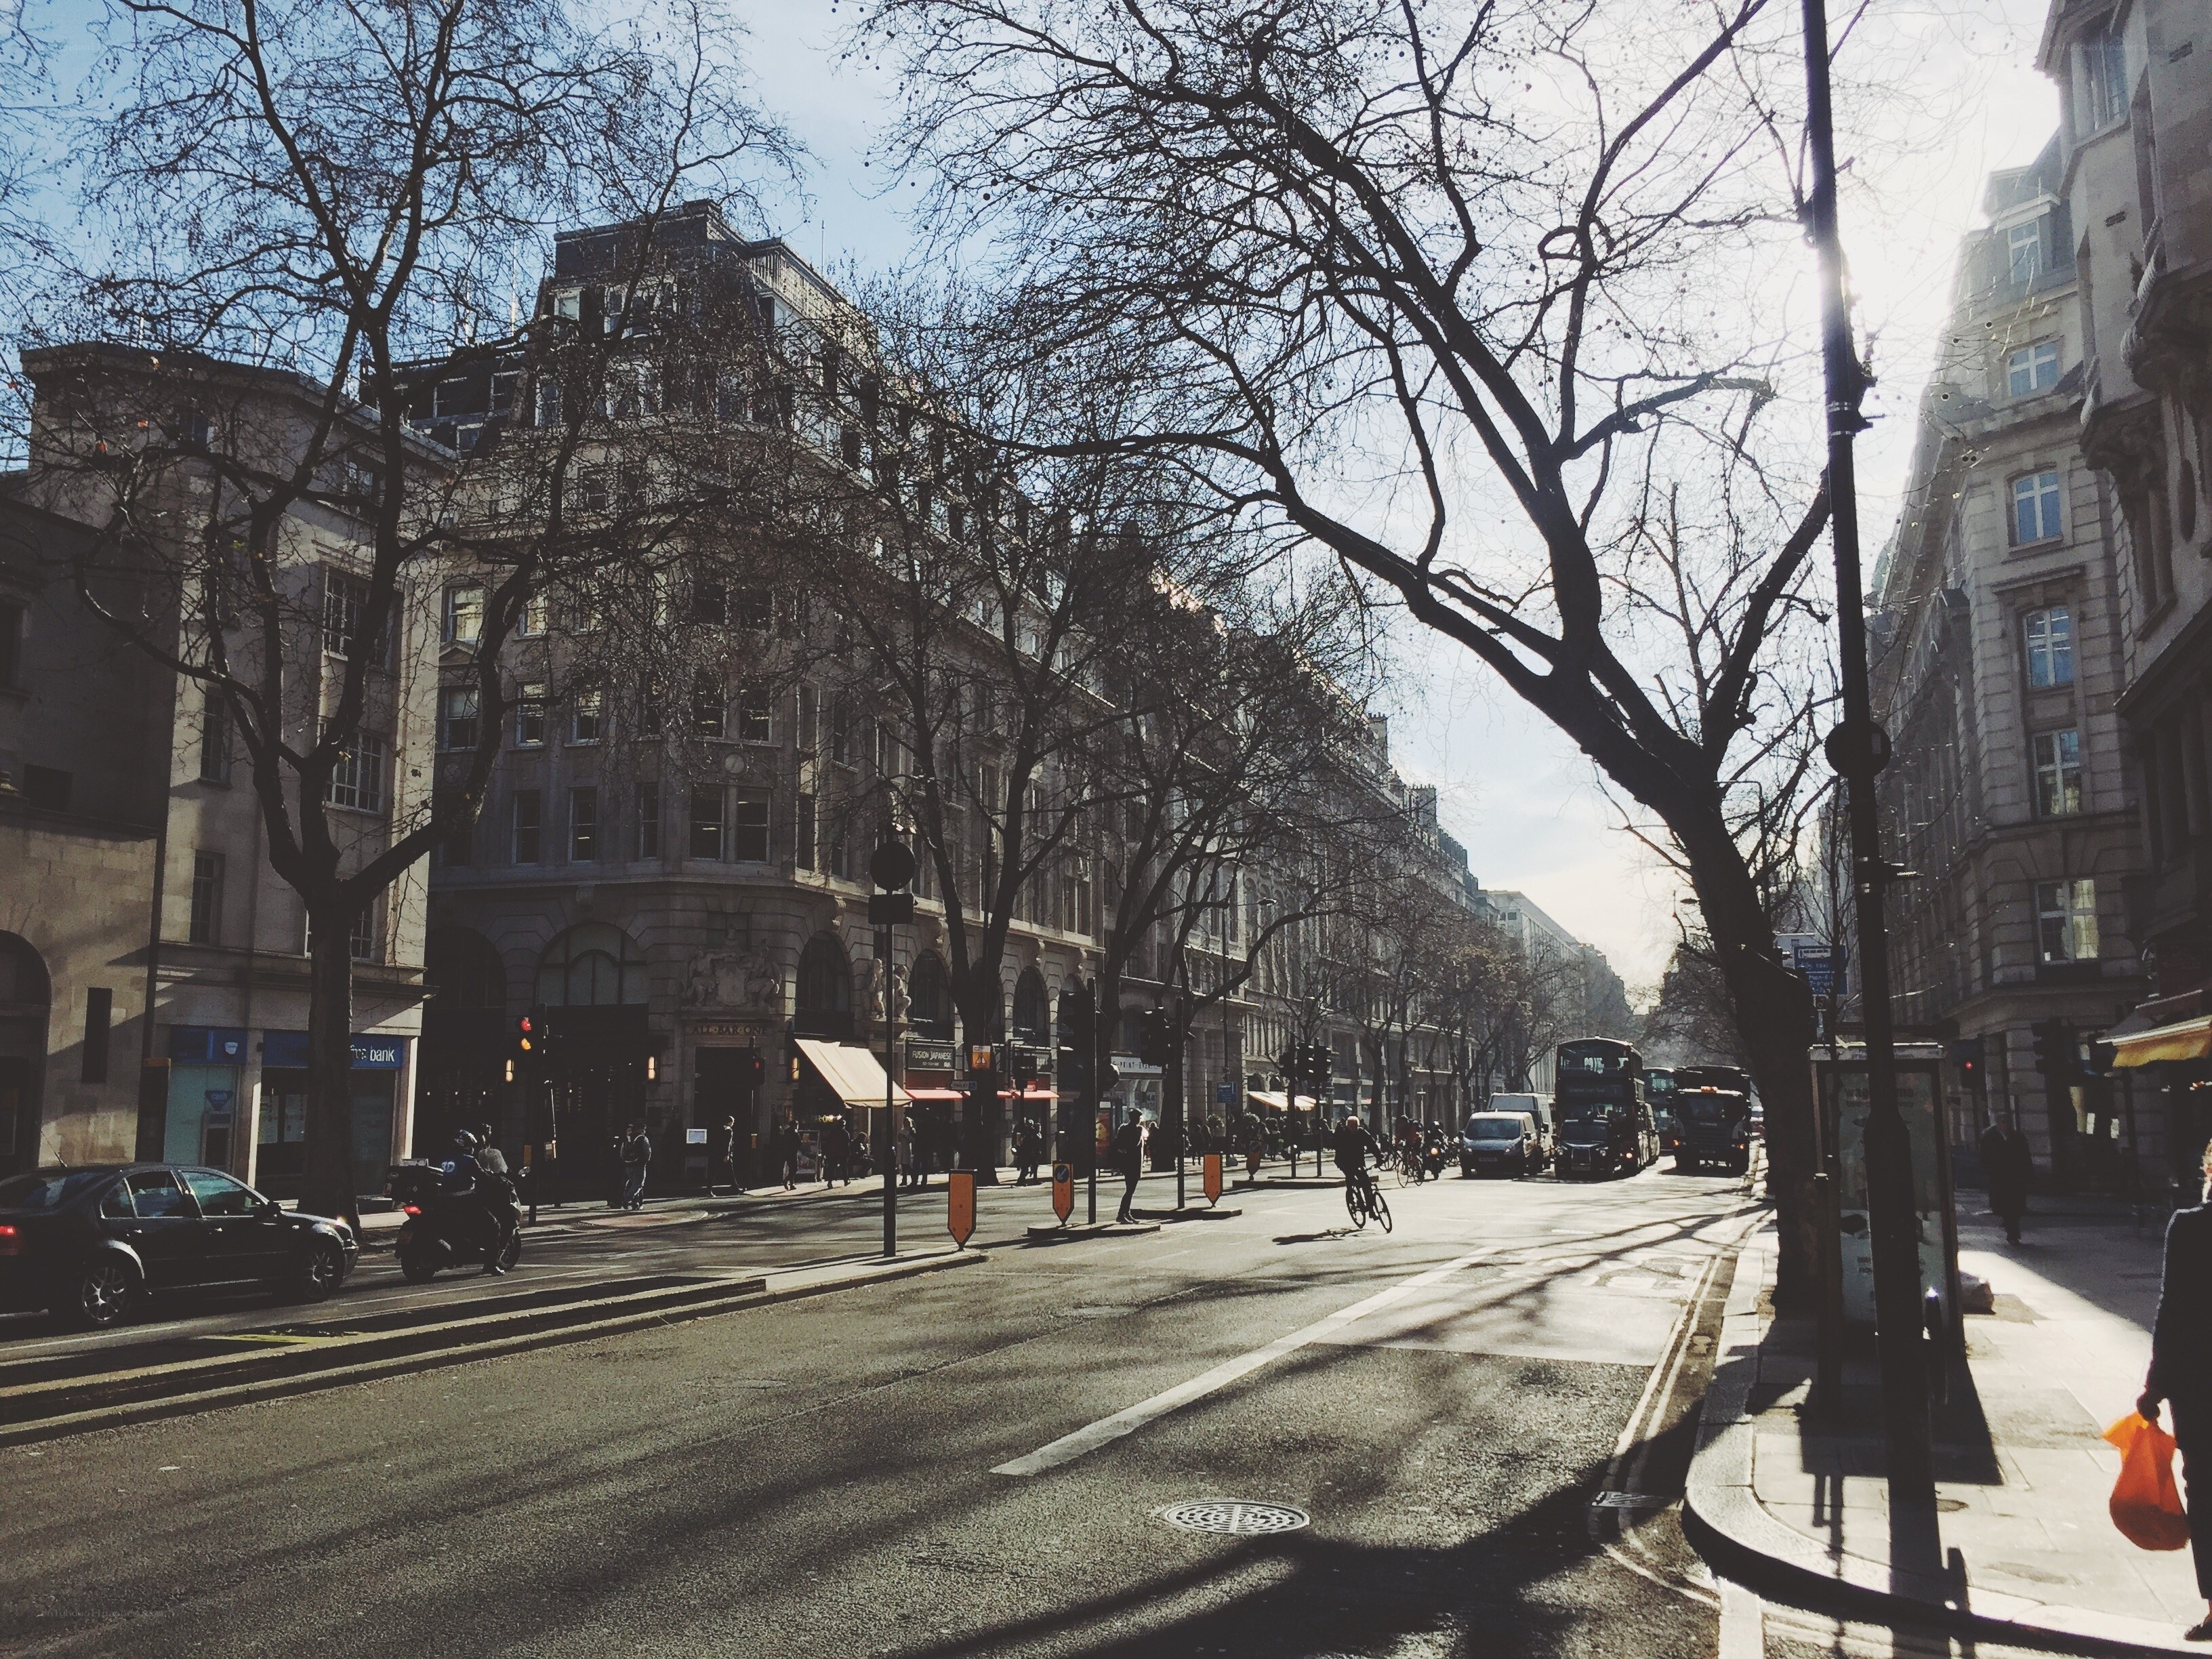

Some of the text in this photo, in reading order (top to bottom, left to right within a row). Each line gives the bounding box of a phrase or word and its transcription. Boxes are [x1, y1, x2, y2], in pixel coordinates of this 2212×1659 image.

[693, 1025, 768, 1034] ALL BAR ONE
[370, 1046, 395, 1062] bank
[912, 1050, 952, 1060] FUSION JAPANESE
[1844, 1088, 1914, 1101] wagma
